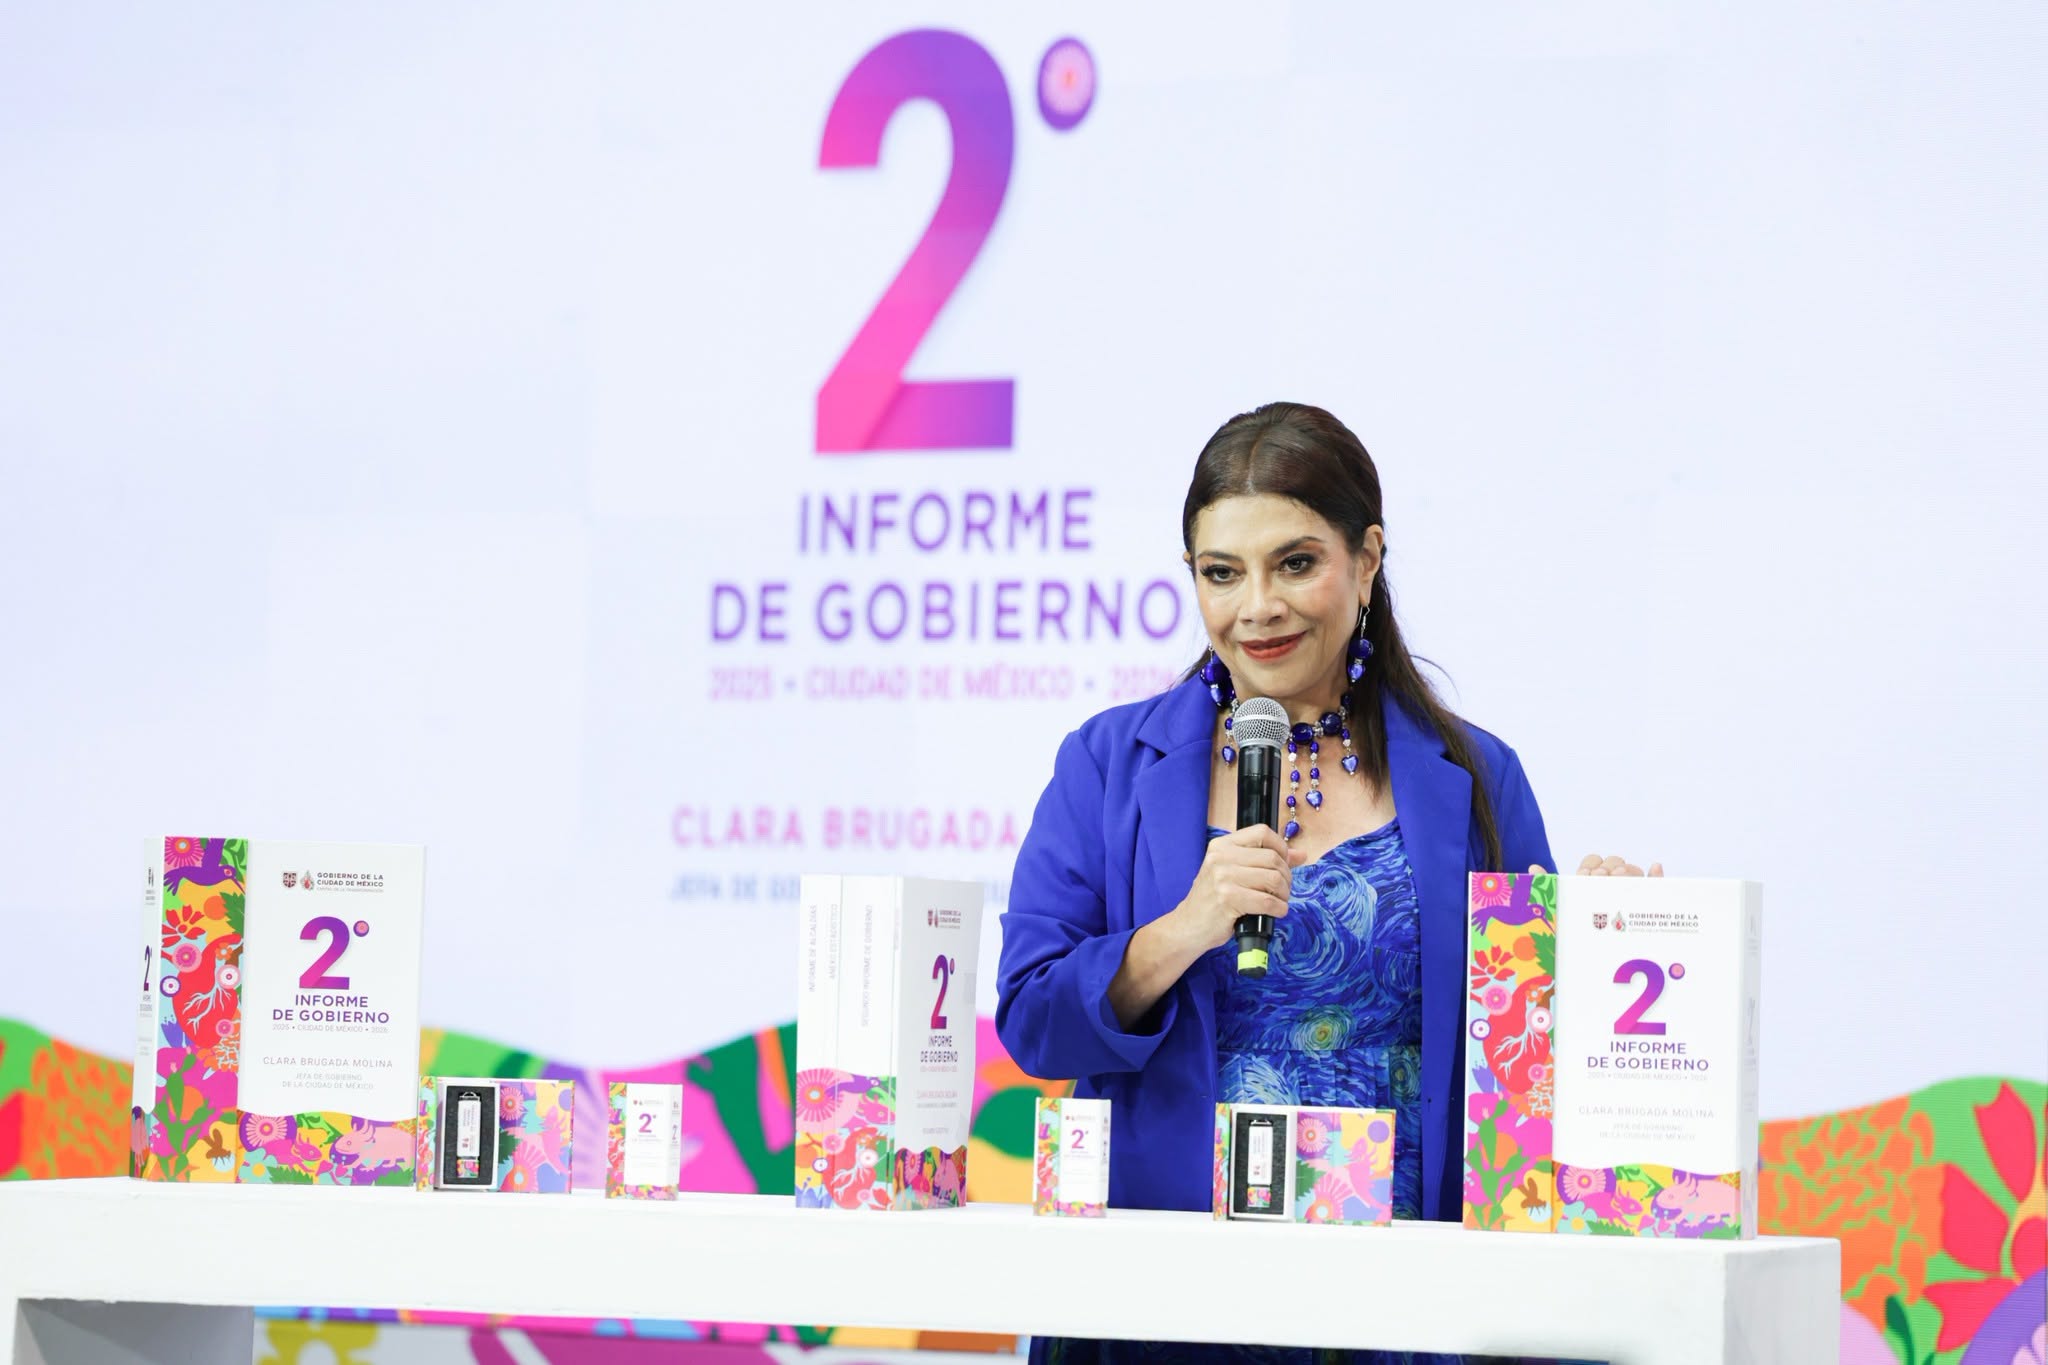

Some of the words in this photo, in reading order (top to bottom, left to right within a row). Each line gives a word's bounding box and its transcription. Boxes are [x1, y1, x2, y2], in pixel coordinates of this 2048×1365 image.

[798, 488, 1095, 554] INFORME
[711, 581, 789, 643] DE
[816, 578, 1183, 642] GOBIERNO
[920, 664, 951, 700] DE
[672, 804, 805, 850] CLARA
[823, 805, 1020, 850] BRUGADA
[317, 872, 359, 880] GOBIERNO
[356, 880, 384, 888] MÉXICO
[295, 994, 369, 1008] INFORME
[273, 1009, 294, 1021] DE
[299, 1010, 390, 1024] GOBIERNO
[297, 1024, 324, 1032] CIUDAD
[1610, 1041, 1687, 1054] INFORME
[263, 1057, 297, 1065] CLARA
[300, 1058, 349, 1067] BRUGADA
[352, 1059, 393, 1068] MOLINA
[1587, 1056, 1609, 1068] DE
[1615, 1057, 1709, 1071] GOBIERNO
[305, 1081, 332, 1089] CIUDAD
[1579, 1106, 1614, 1115] CLARA
[1617, 1107, 1668, 1117] BRUGADA
[1672, 1109, 1714, 1118] MOLINA
